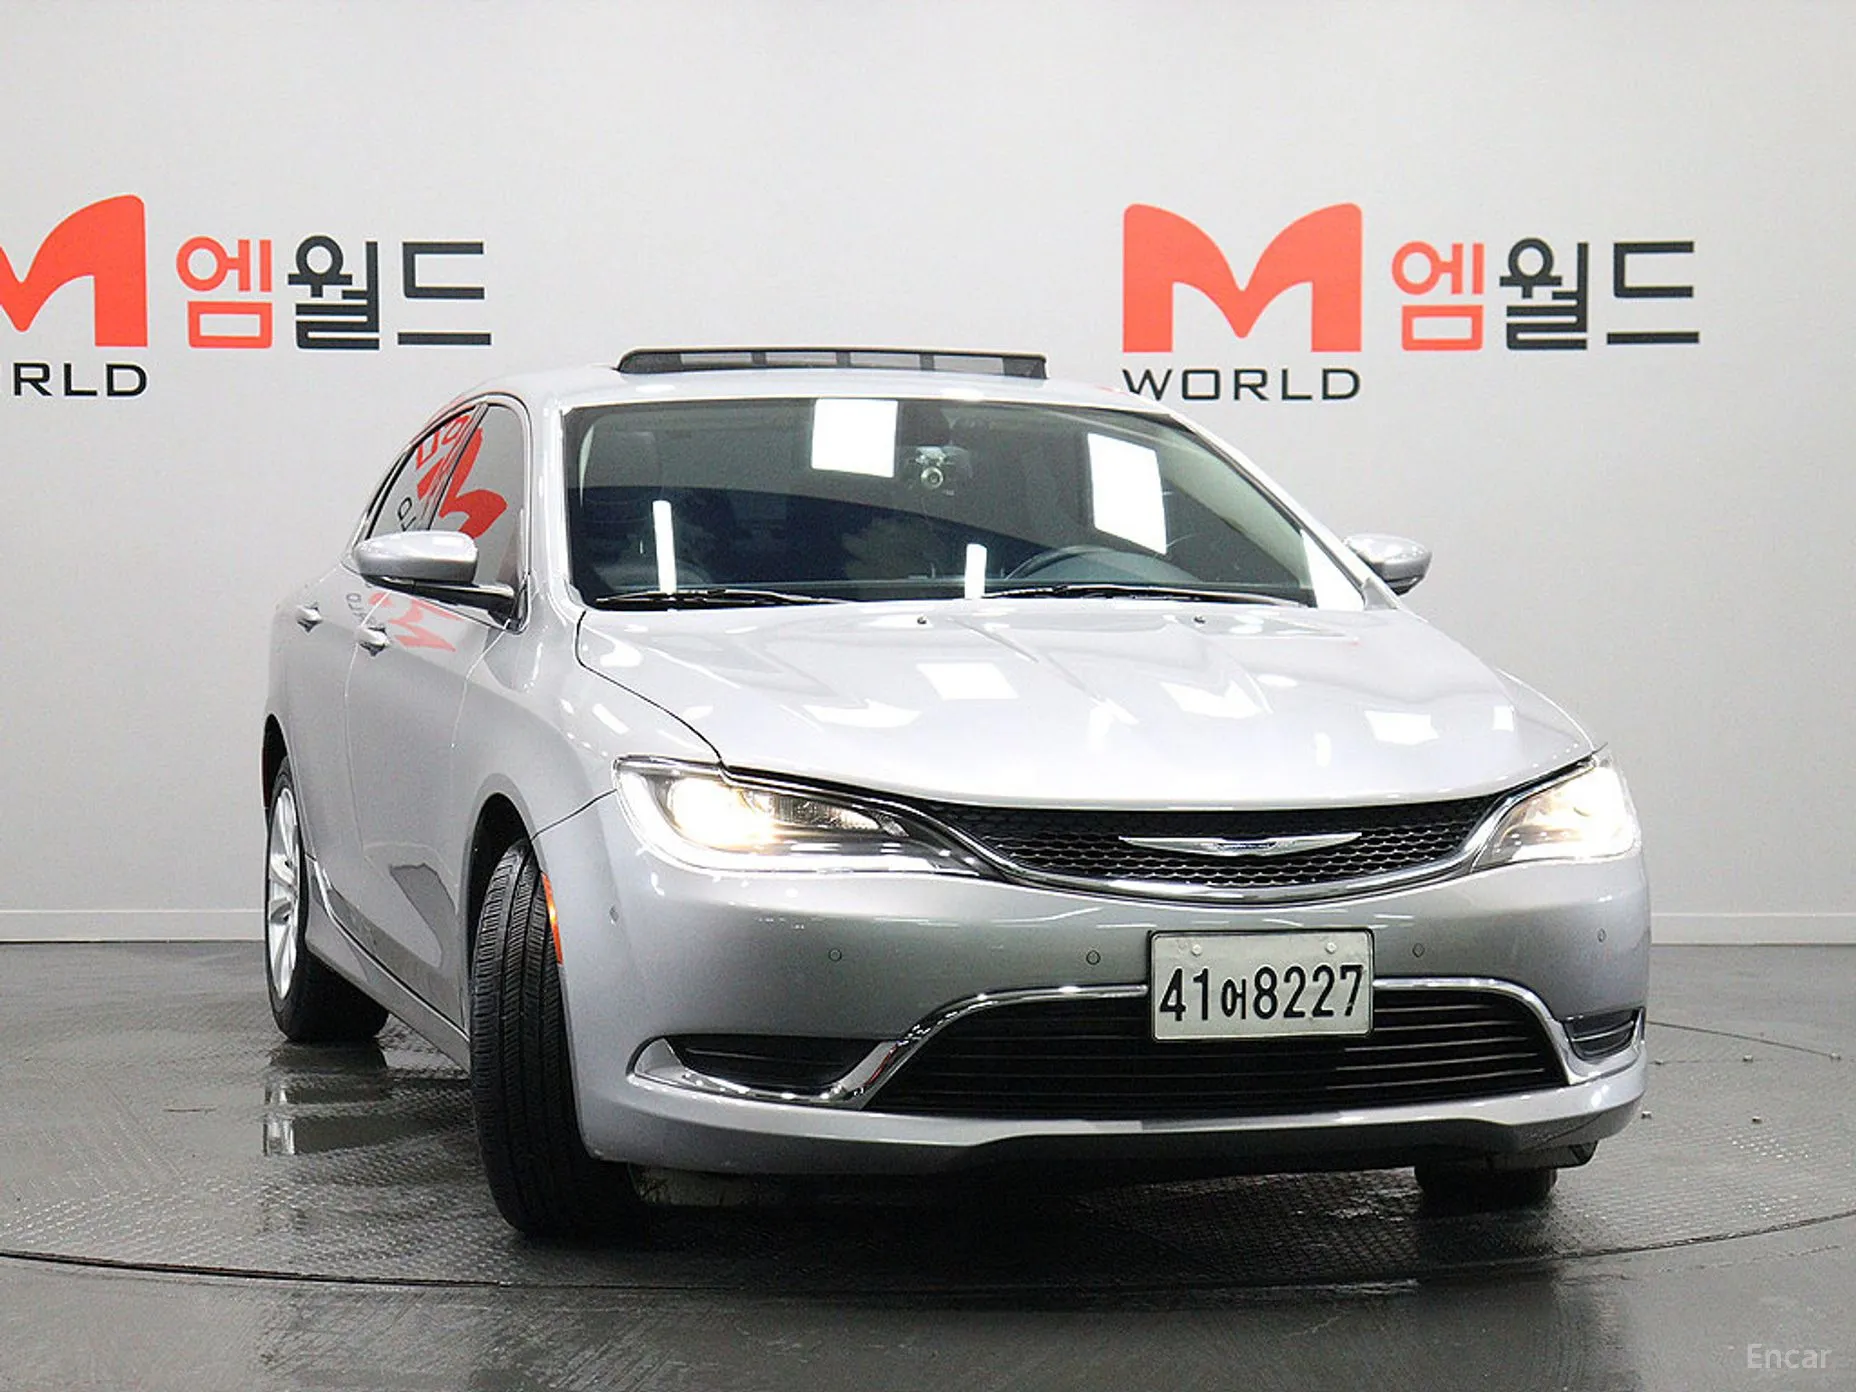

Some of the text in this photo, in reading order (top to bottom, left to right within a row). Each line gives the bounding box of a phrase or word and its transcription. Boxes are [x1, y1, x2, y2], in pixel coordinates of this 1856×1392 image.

[176, 235, 492, 350] 엠월드
[1122, 203, 1362, 352] M
[1391, 237, 1700, 350] 엠월드
[13, 362, 147, 397] RLD
[1122, 368, 1361, 401] WORLD
[1159, 964, 1363, 1021] 41어8227
